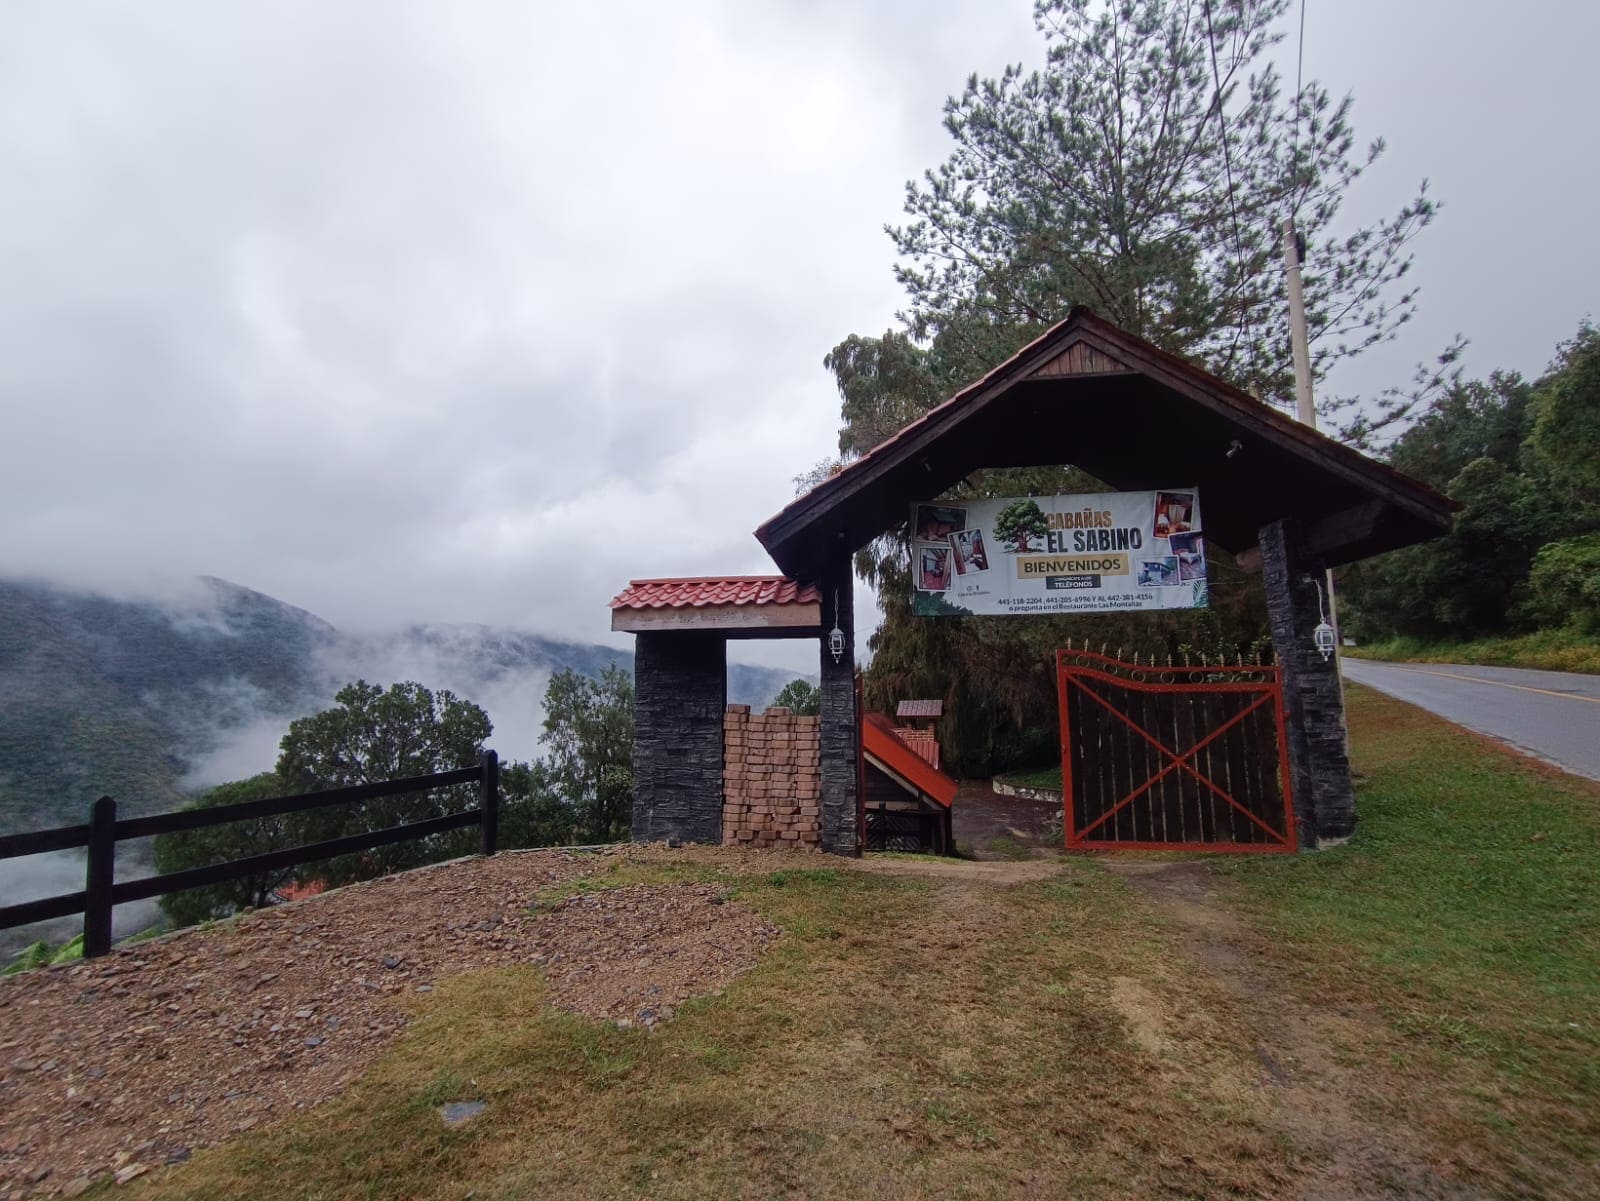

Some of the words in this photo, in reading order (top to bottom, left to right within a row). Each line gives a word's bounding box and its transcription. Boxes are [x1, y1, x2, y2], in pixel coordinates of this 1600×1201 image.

[1047, 507, 1113, 530] CABAÑAS
[1047, 531, 1069, 553] EL
[1073, 527, 1143, 552] SABINO
[1024, 558, 1121, 573] BIENVENIDOS
